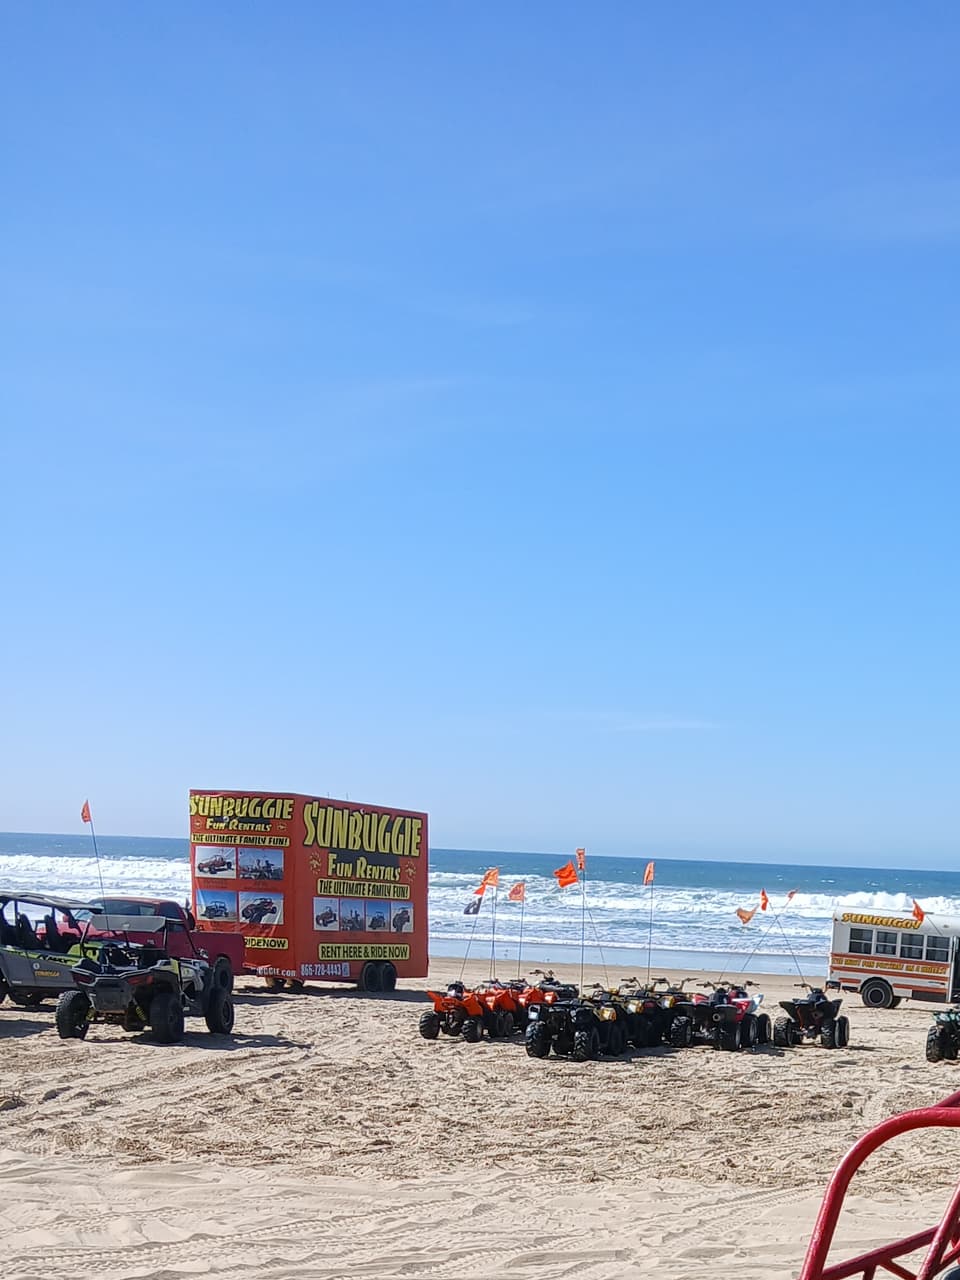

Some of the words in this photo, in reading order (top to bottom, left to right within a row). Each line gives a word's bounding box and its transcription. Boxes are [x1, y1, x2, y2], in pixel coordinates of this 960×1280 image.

[190, 795, 294, 819] SUNBUGGIE
[303, 801, 422, 857] SUNBUGGIE
[193, 834, 205, 843] THE
[205, 835, 238, 844] ULTIMATE
[240, 836, 266, 846] FAMILY
[268, 837, 288, 846] FUN!
[320, 880, 332, 894] THE
[334, 881, 366, 896] ULTIMATE
[367, 884, 392, 897] FAMILY
[393, 885, 409, 898] FUN!
[321, 945, 343, 958] RENT
[343, 946, 363, 958] HERE
[364, 946, 370, 958] &
[370, 946, 388, 958] RIDE
[389, 946, 408, 958] NOW
